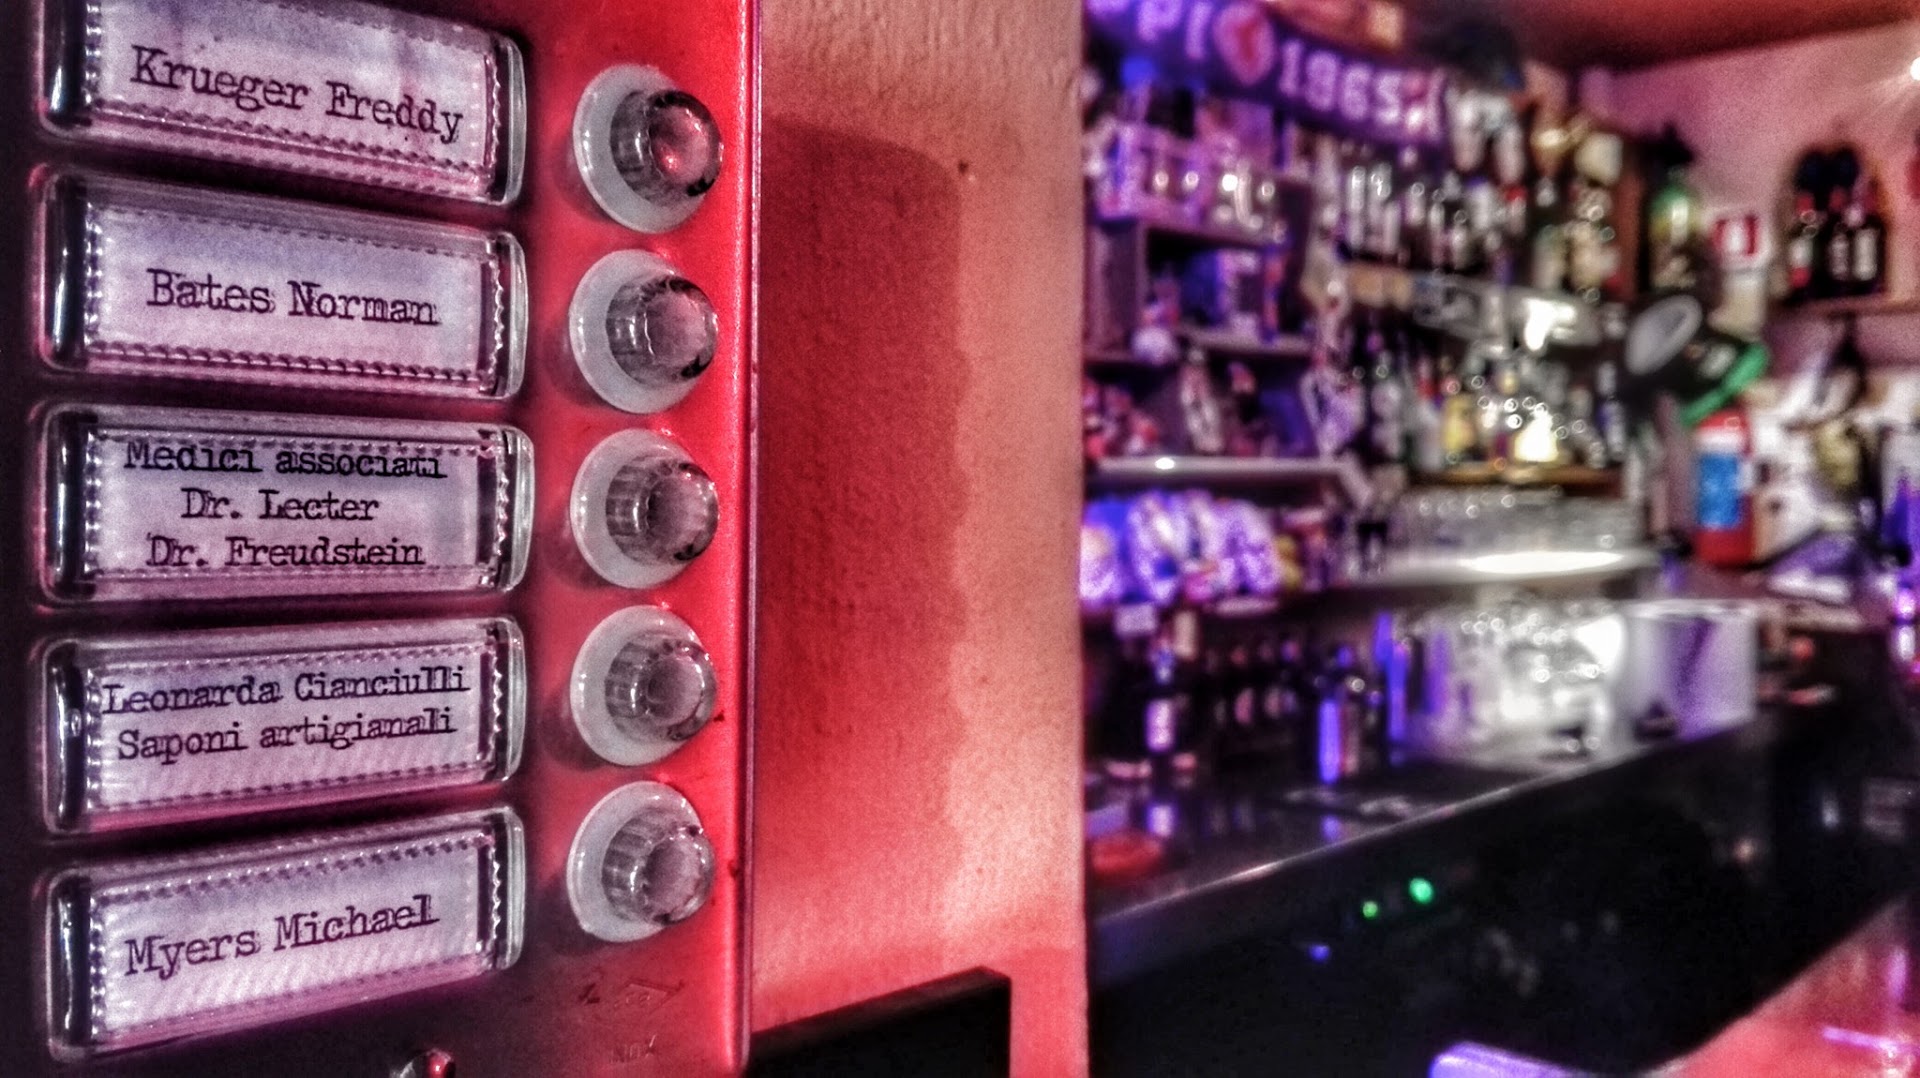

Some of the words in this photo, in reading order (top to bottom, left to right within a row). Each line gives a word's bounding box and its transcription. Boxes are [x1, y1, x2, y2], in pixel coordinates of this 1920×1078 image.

[131, 45, 311, 112] Krueger
[325, 81, 464, 145] Freddy
[146, 267, 276, 315] Bates
[287, 281, 441, 326] Norman
[124, 440, 263, 474] Medici
[275, 444, 447, 479] associati
[180, 487, 242, 520] Dr.
[258, 489, 379, 522] Lecter
[145, 532, 208, 567] Dr.
[224, 536, 426, 567] Freudstein
[102, 674, 281, 715] Leonarda
[294, 665, 470, 701] Cianciulli
[117, 722, 247, 765] Saponi
[259, 706, 457, 750] artigianali
[125, 930, 261, 980] Myers
[274, 894, 440, 953] Michael
